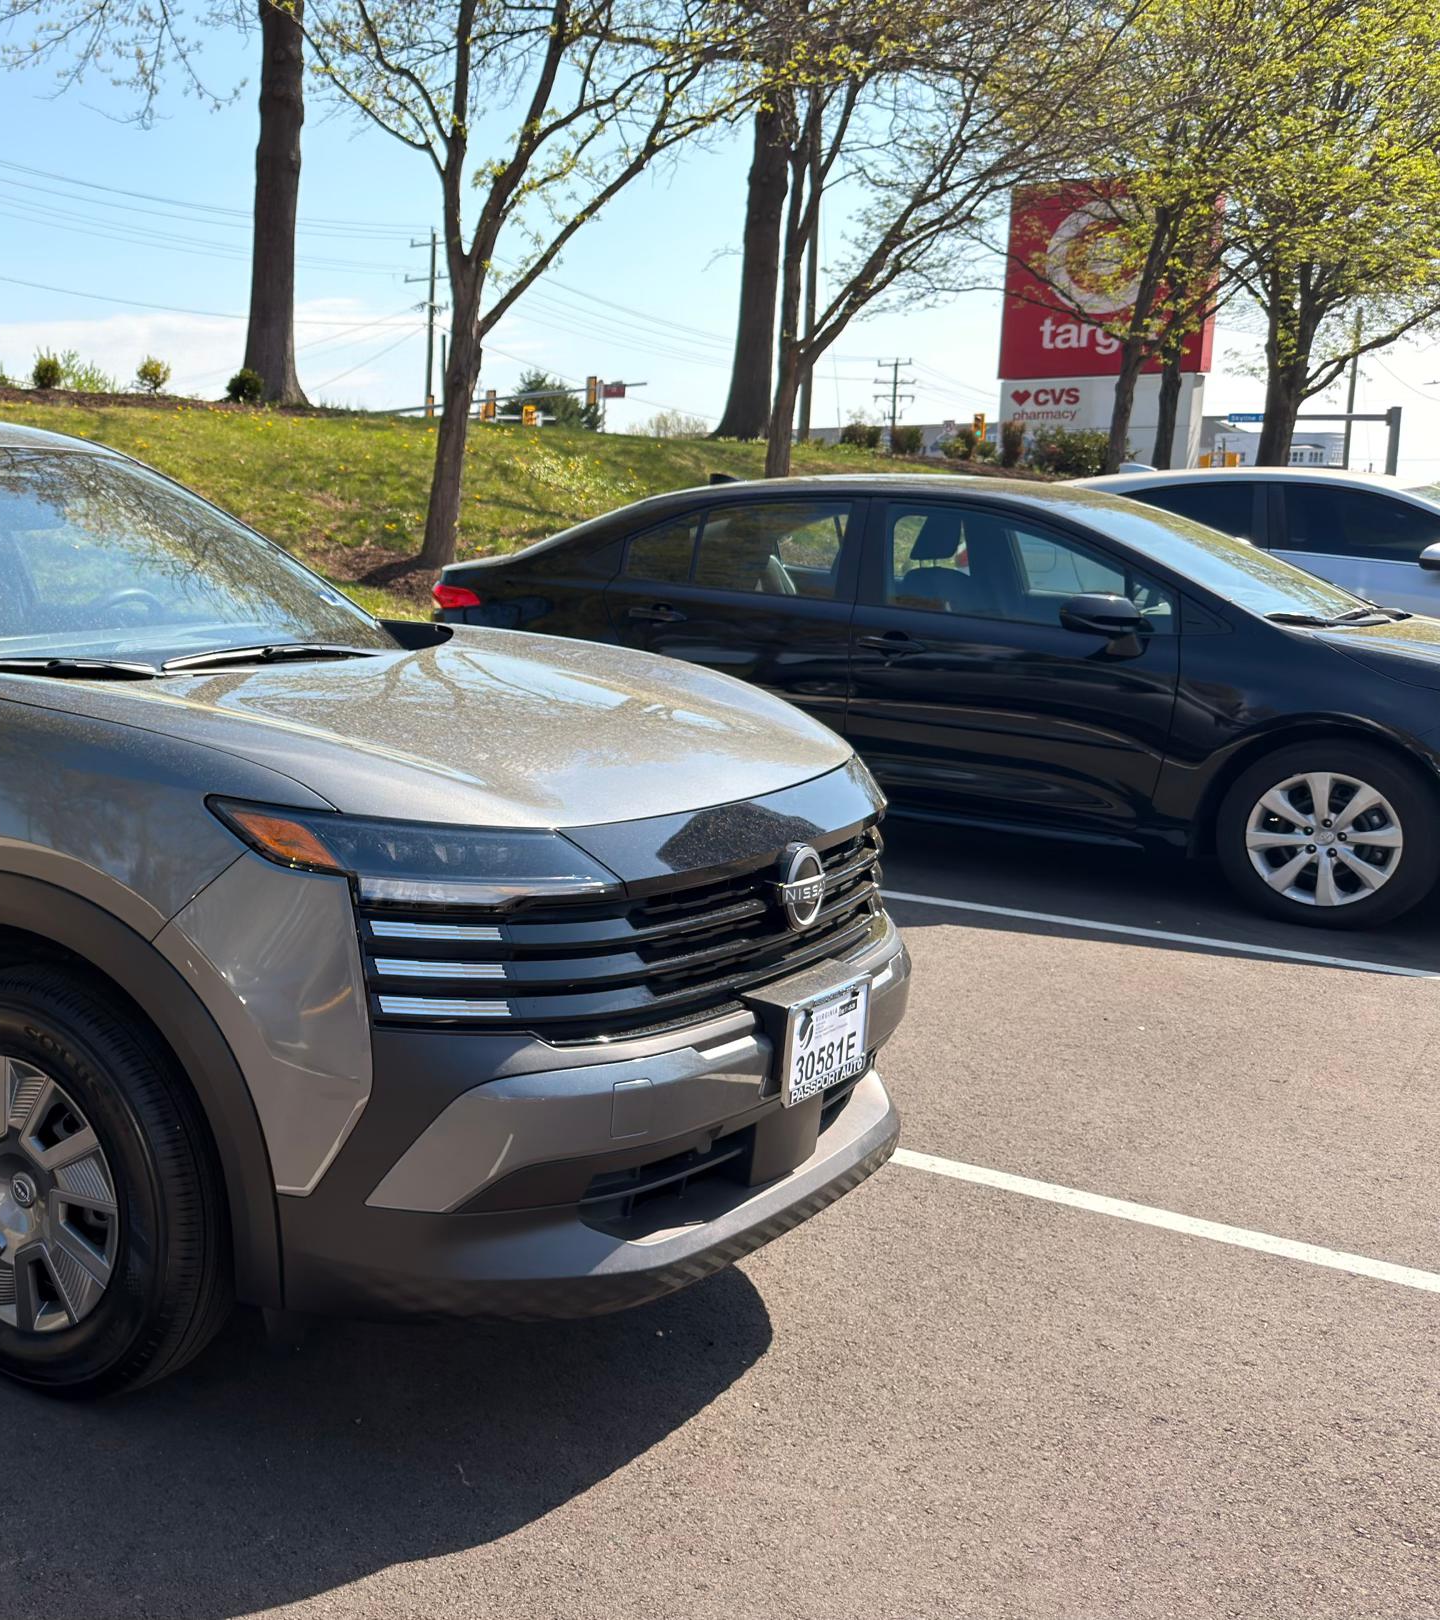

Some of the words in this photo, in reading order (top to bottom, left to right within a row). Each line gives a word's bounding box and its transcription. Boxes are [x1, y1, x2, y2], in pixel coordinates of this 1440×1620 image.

[1040, 317, 1158, 355] targ
[1033, 387, 1080, 406] CVS
[1013, 410, 1076, 421] pharmacy
[815, 1006, 838, 1023] VIRGINIA
[794, 1031, 856, 1086] 30581E
